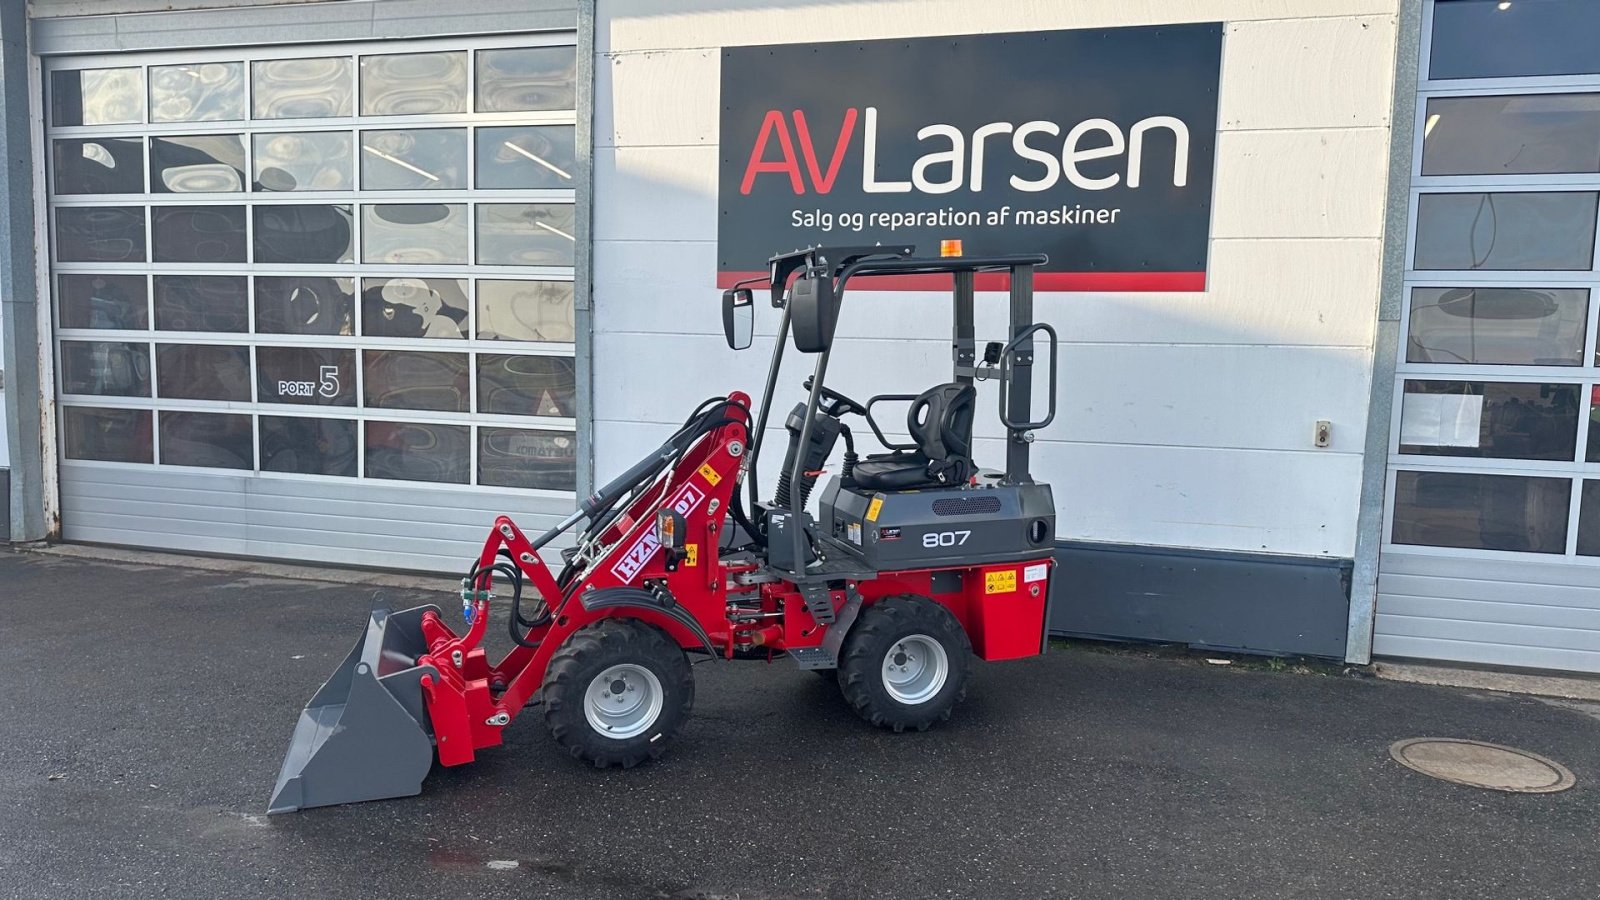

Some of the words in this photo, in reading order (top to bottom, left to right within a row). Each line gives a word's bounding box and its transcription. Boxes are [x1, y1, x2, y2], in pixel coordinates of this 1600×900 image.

[791, 208, 833, 232] Salg
[838, 212, 864, 232] og
[869, 207, 981, 231] reparation
[986, 205, 1011, 226] af
[1015, 204, 1121, 225] maskiner
[278, 380, 316, 397] PORT
[318, 365, 340, 398] 5
[922, 530, 972, 548] 807
